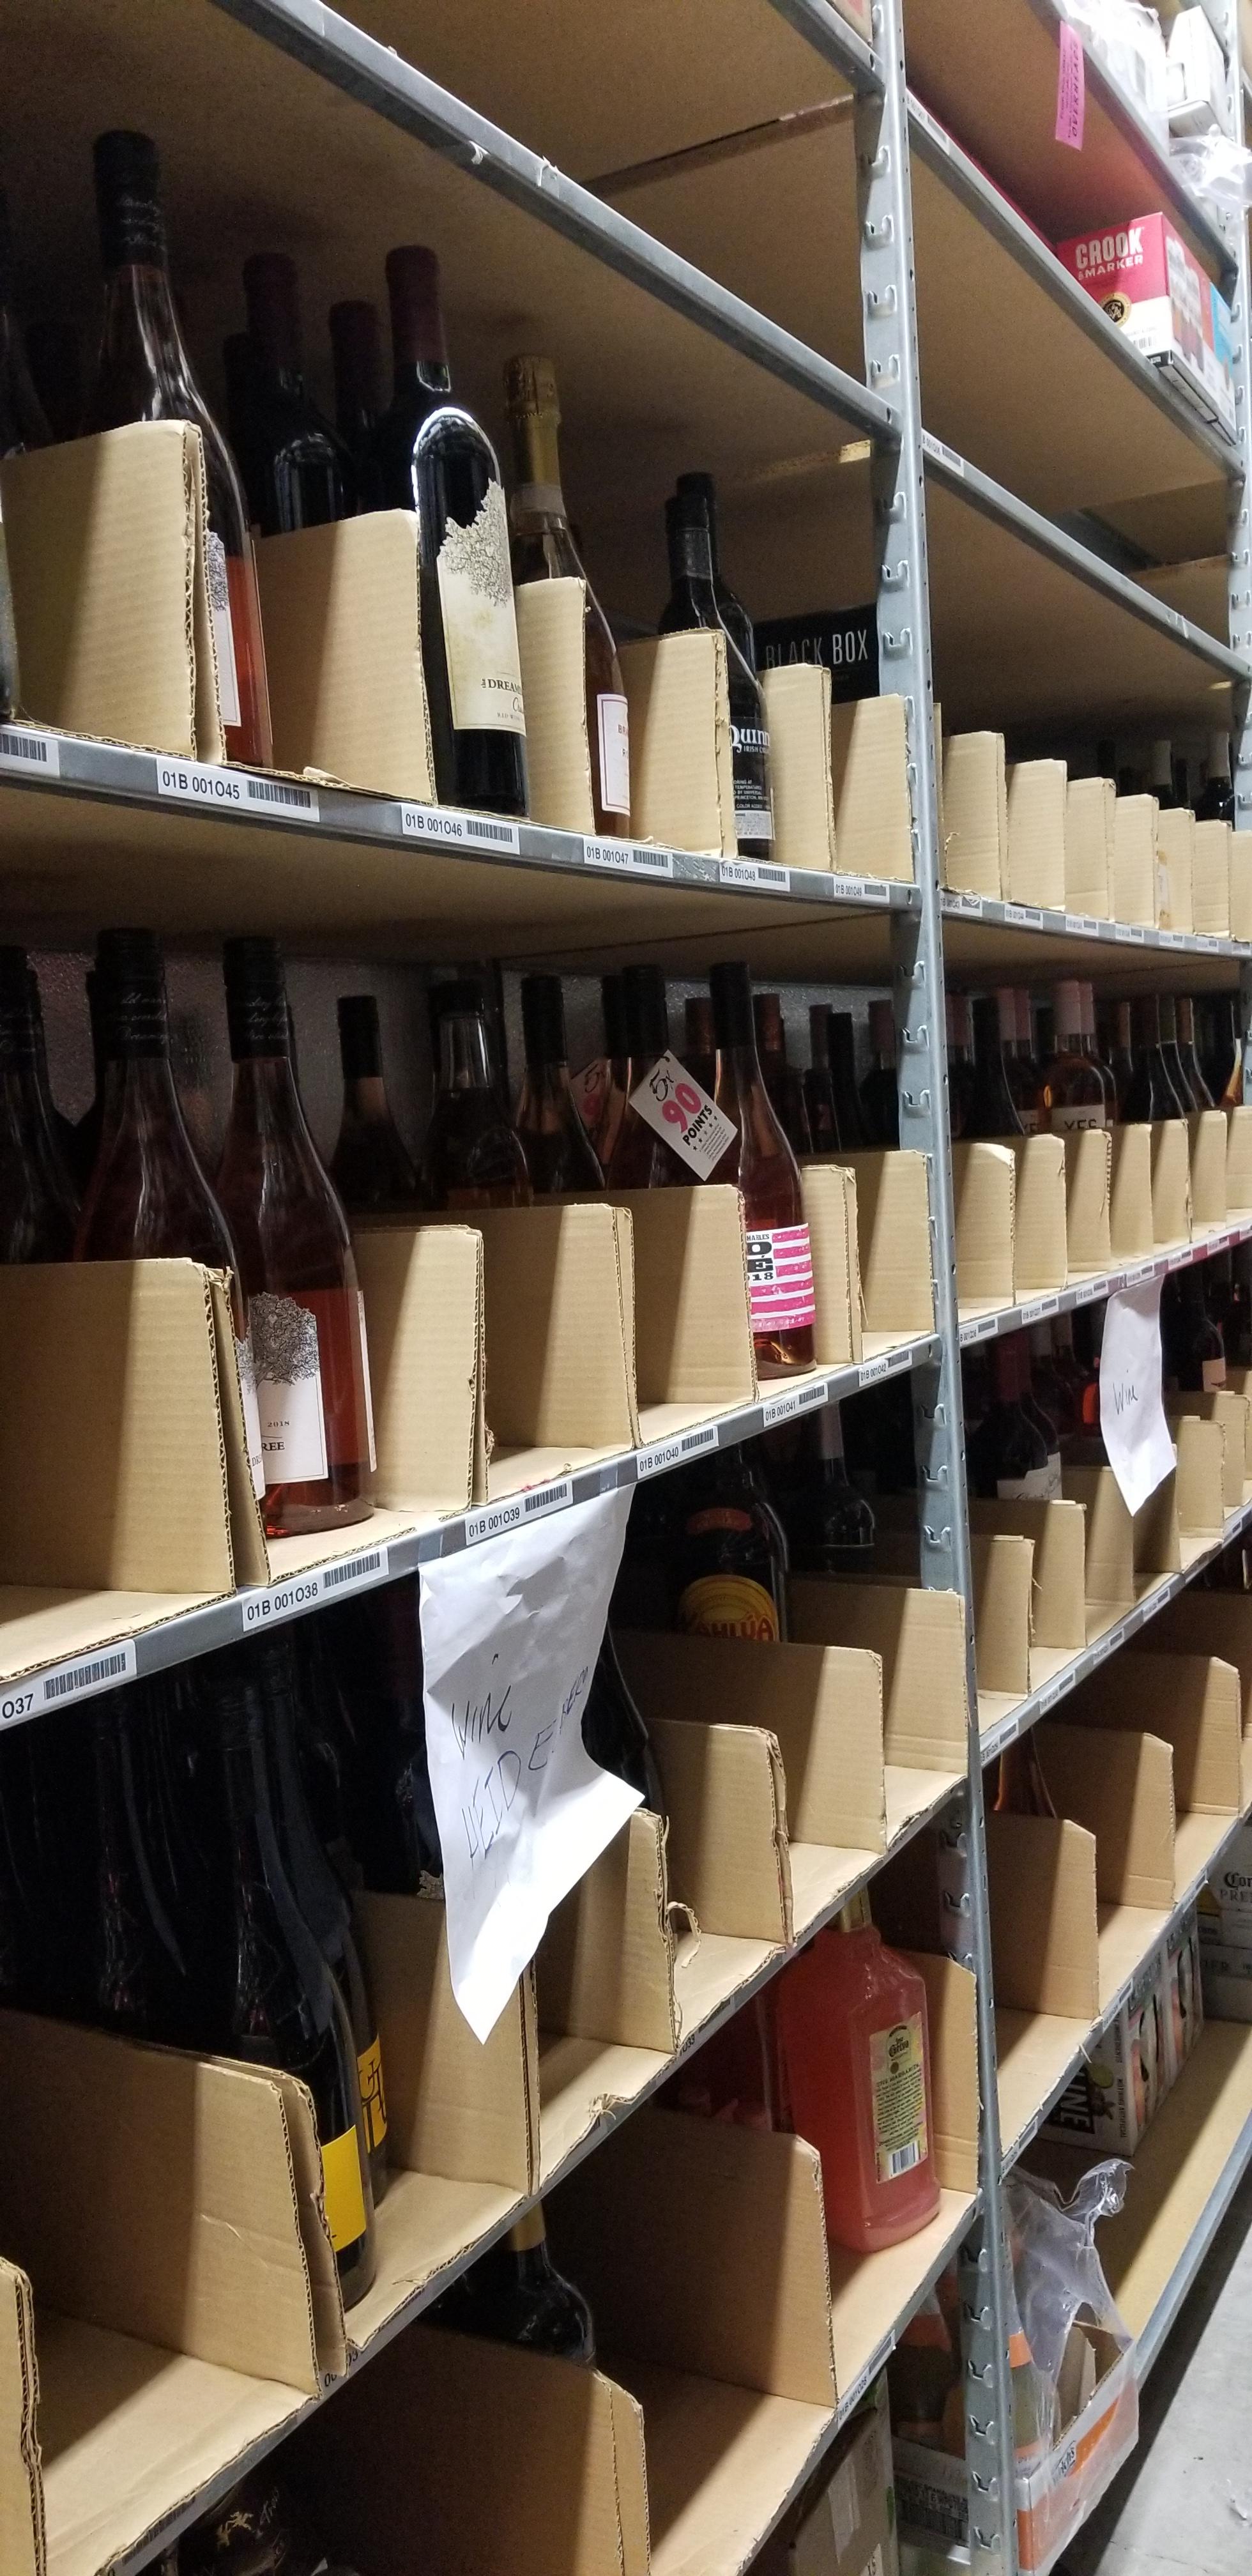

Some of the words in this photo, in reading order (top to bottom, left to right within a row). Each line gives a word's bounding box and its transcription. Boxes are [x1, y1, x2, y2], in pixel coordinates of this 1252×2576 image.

[1076, 227, 1143, 269] CROOK
[766, 638, 823, 670] BLACK
[832, 629, 868, 664] BOX
[162, 770, 188, 790] 01B
[406, 813, 424, 829] 01B
[586, 846, 600, 859] 01B
[721, 866, 733, 877] 01B
[662, 1083, 701, 1133] 90
[682, 1104, 712, 1146] POINTS
[747, 1272, 774, 1282] 18
[860, 1369, 870, 1382] 01B
[765, 1408, 775, 1422] 01B
[261, 1441, 285, 1452] REE
[639, 1457, 653, 1472] 01B
[469, 1519, 486, 1538] 01B
[247, 1599, 271, 1621] 01B
[1219, 1889, 1252, 1903] PRE
